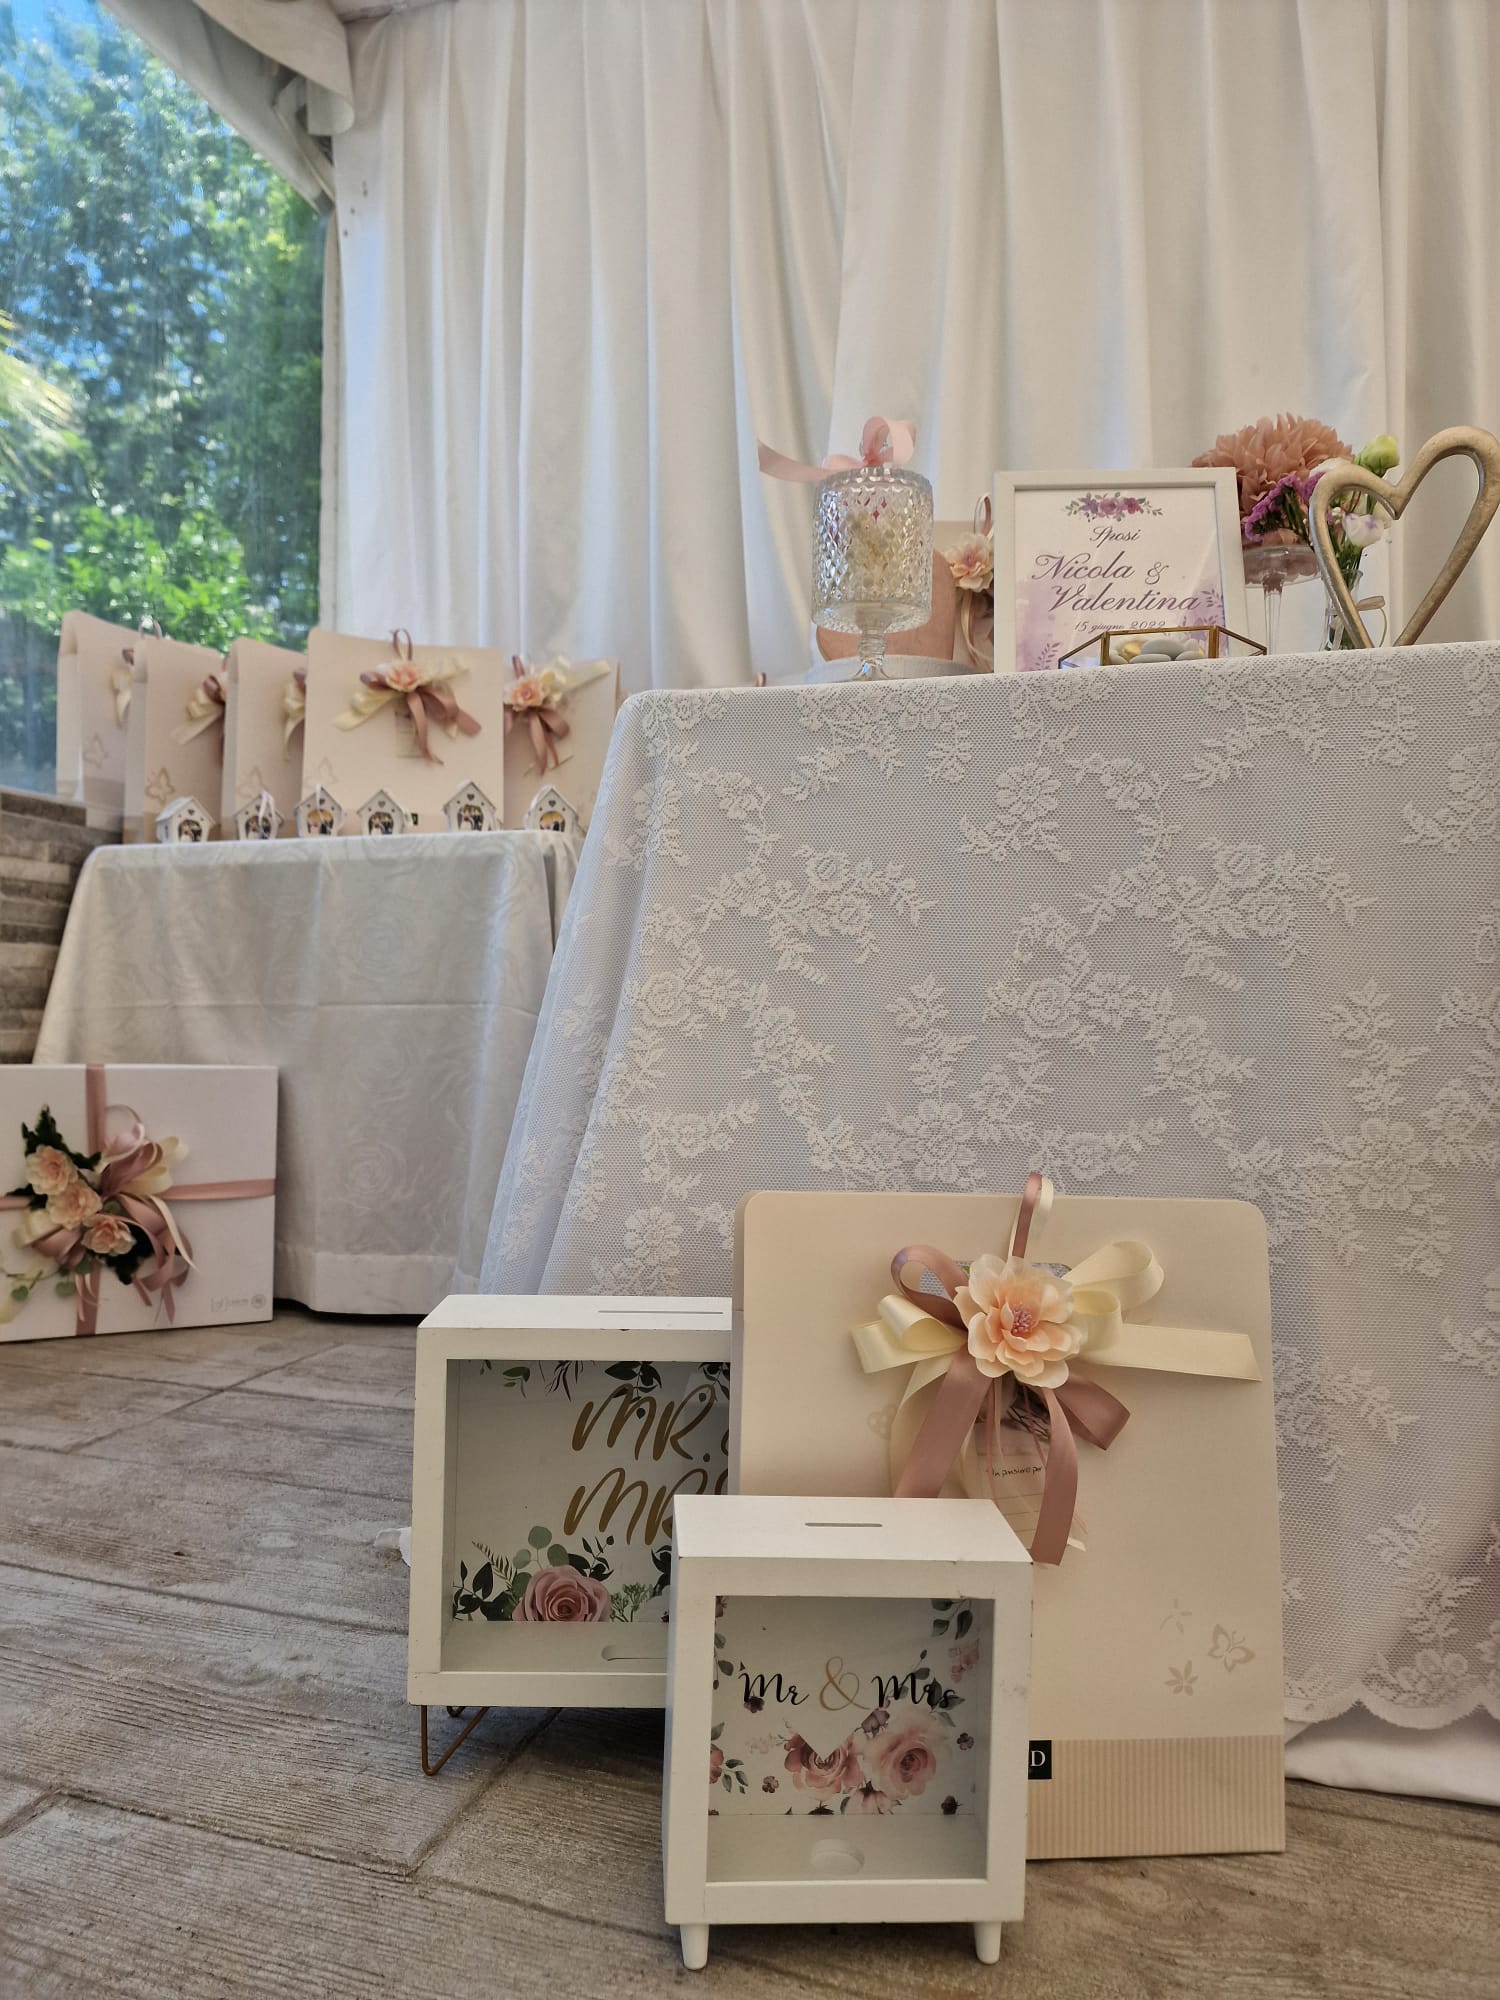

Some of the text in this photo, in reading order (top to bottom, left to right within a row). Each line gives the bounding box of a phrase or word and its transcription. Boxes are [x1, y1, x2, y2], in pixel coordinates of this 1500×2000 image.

[1089, 526, 1141, 548] Sposi
[1032, 551, 1169, 585] Nicola &
[1048, 583, 1201, 612] Valentina
[1074, 621, 1088, 631] 15
[1088, 623, 1125, 634] giugno
[738, 1656, 956, 1711] Mr & Mrs
[1030, 1750, 1046, 1767] D
